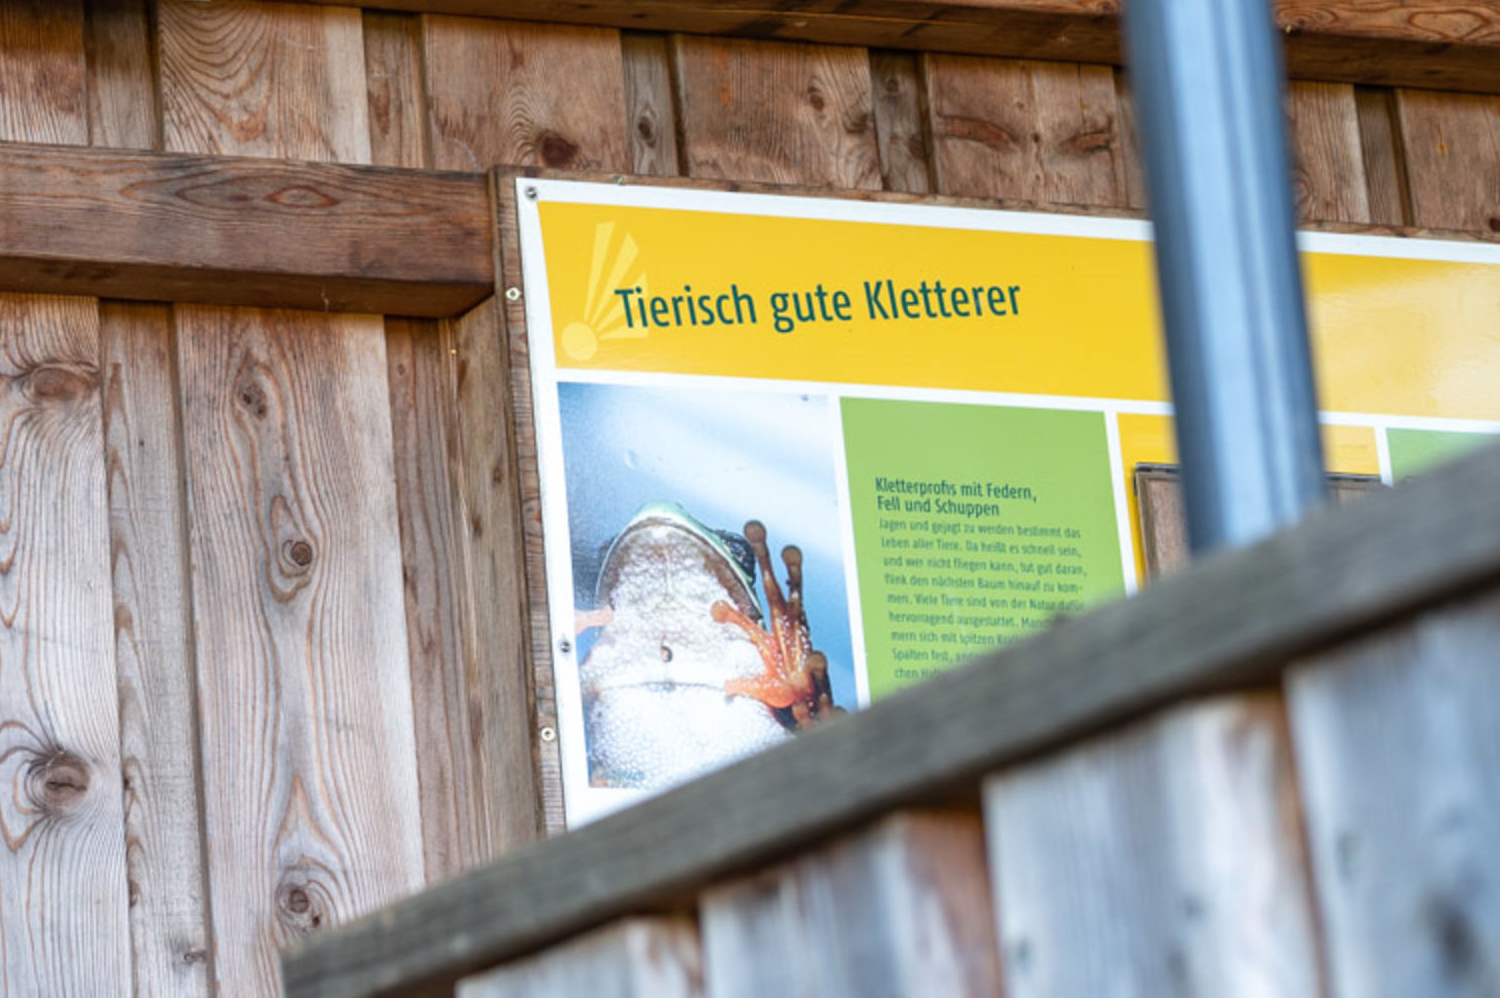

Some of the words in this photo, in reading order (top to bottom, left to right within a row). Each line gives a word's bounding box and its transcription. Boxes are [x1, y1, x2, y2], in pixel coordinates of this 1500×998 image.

[614, 285, 757, 328] Tierisch
[770, 284, 852, 334] gute
[863, 279, 1021, 320] Kletterer
[875, 478, 957, 496] Kletterprofis
[961, 482, 982, 497] mit
[986, 483, 1037, 502] Federn,
[877, 495, 900, 510] Fell
[905, 497, 931, 512] und
[935, 498, 1000, 518] Schuppen
[909, 520, 929, 531] und
[978, 523, 1014, 535] werden
[1017, 525, 1062, 538] bestimmt
[1064, 527, 1080, 538] das
[1009, 545, 1019, 554] es
[1021, 543, 1056, 555] schnell
[883, 555, 902, 567] und
[953, 557, 986, 572] fliegen
[910, 574, 929, 586] den
[977, 577, 1005, 590] Baum
